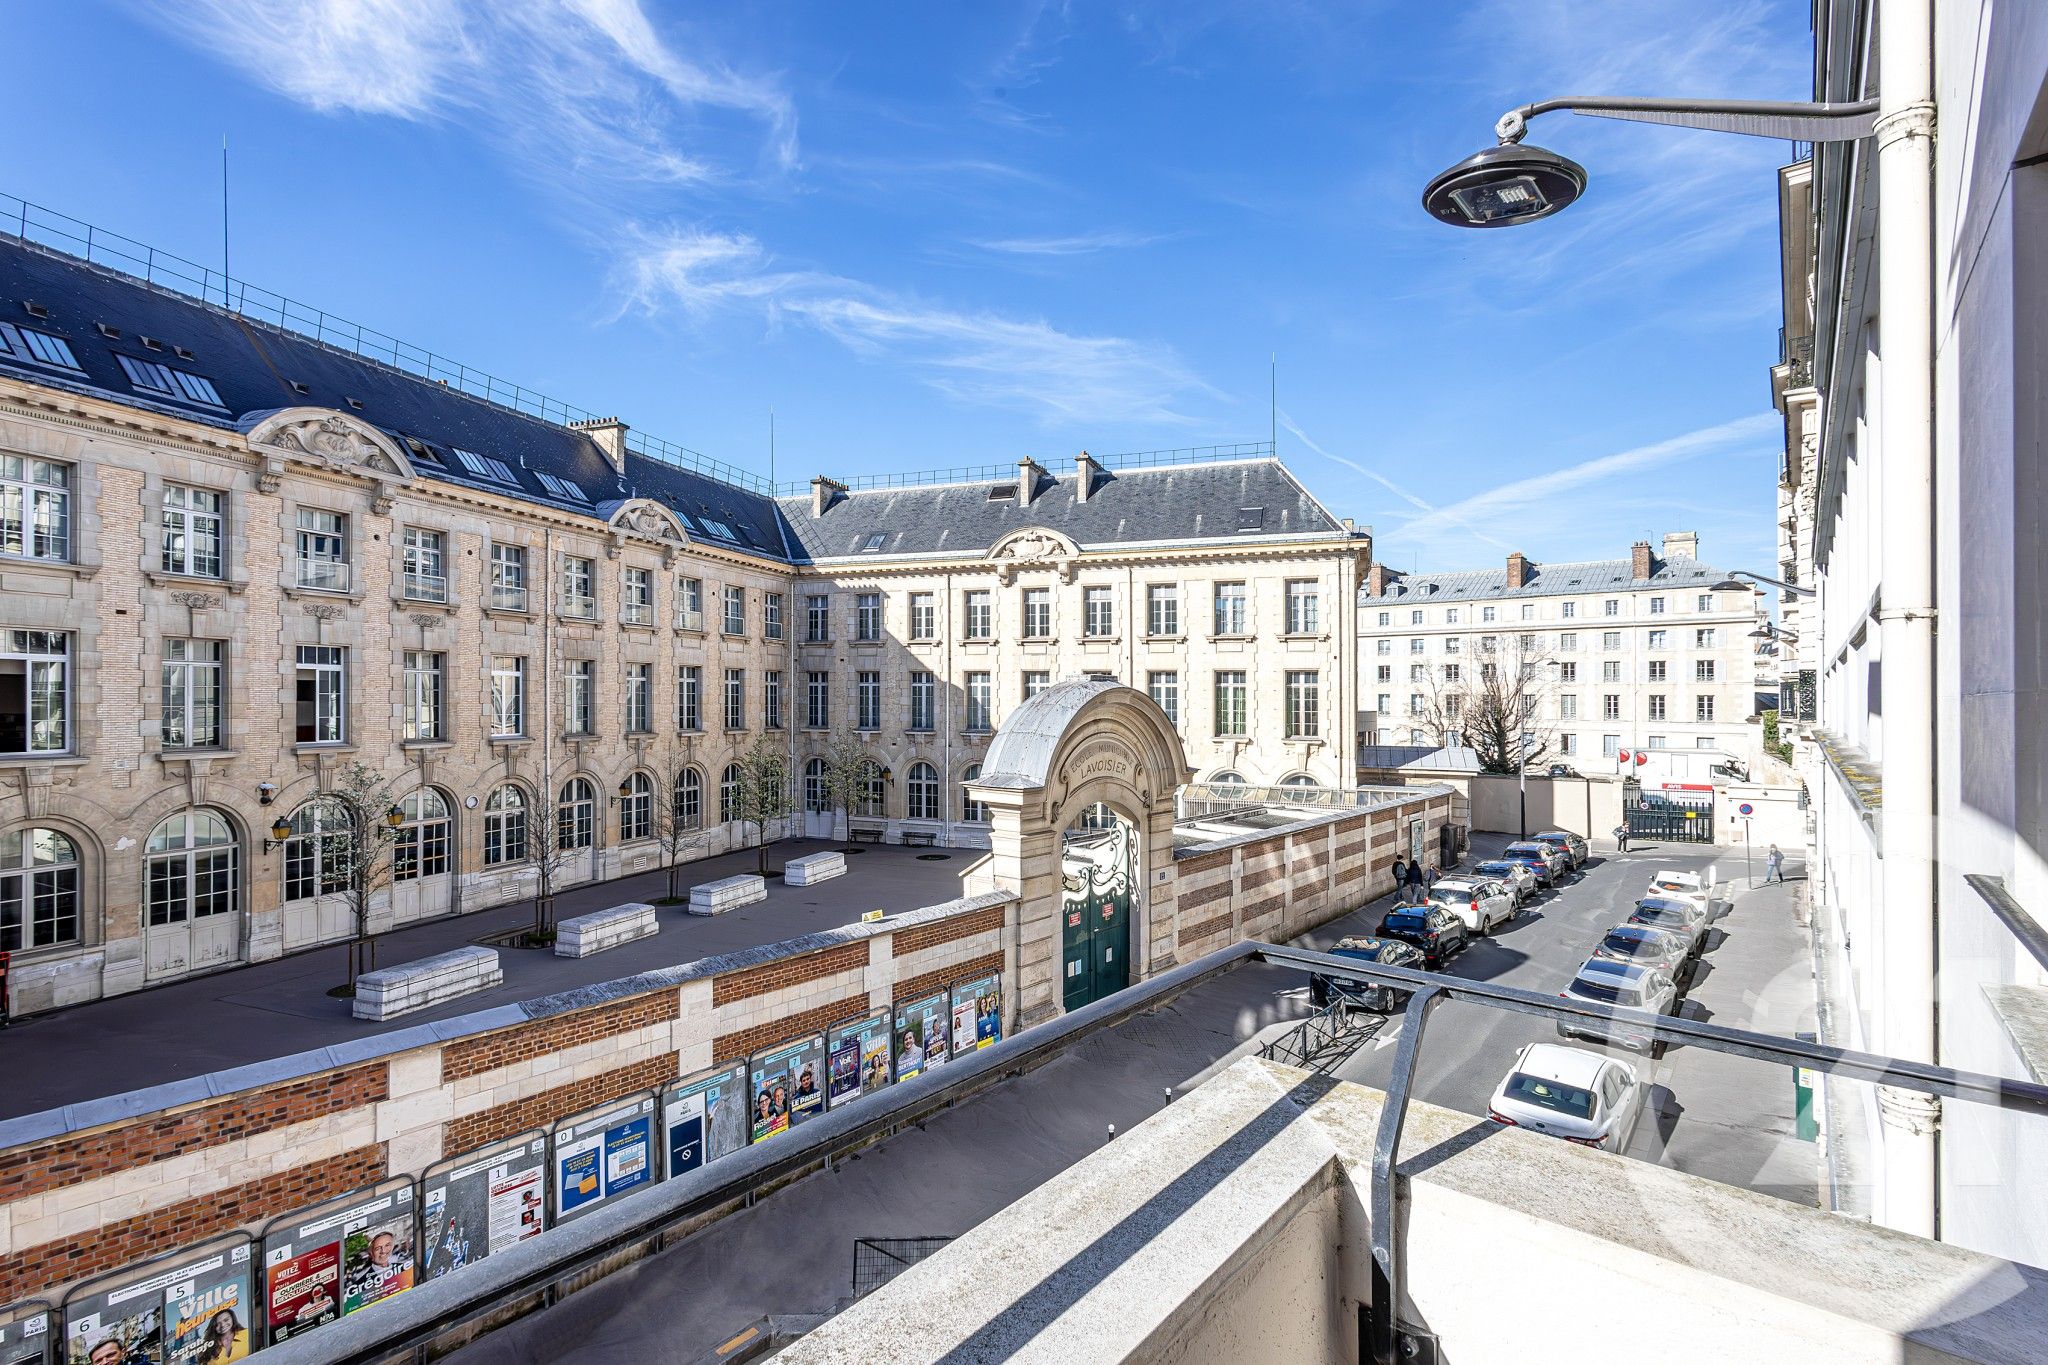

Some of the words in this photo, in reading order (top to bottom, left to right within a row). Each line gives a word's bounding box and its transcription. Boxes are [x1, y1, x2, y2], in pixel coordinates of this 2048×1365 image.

[1081, 760, 1127, 779] LAVOISIER
[711, 1089, 716, 1097] 9
[495, 1169, 501, 1179] 1
[432, 1192, 439, 1202] 2
[275, 1250, 284, 1261] 4
[277, 1264, 299, 1278] VOTEZ
[346, 1259, 414, 1298] Grégoire
[176, 1286, 185, 1298] 5
[180, 1284, 238, 1319] Ville
[175, 1297, 239, 1340] heureuse
[25, 1326, 47, 1336] PARIS
[79, 1320, 90, 1332] 6
[170, 1338, 206, 1359] Sarah
[180, 1340, 215, 1361] Knafo
